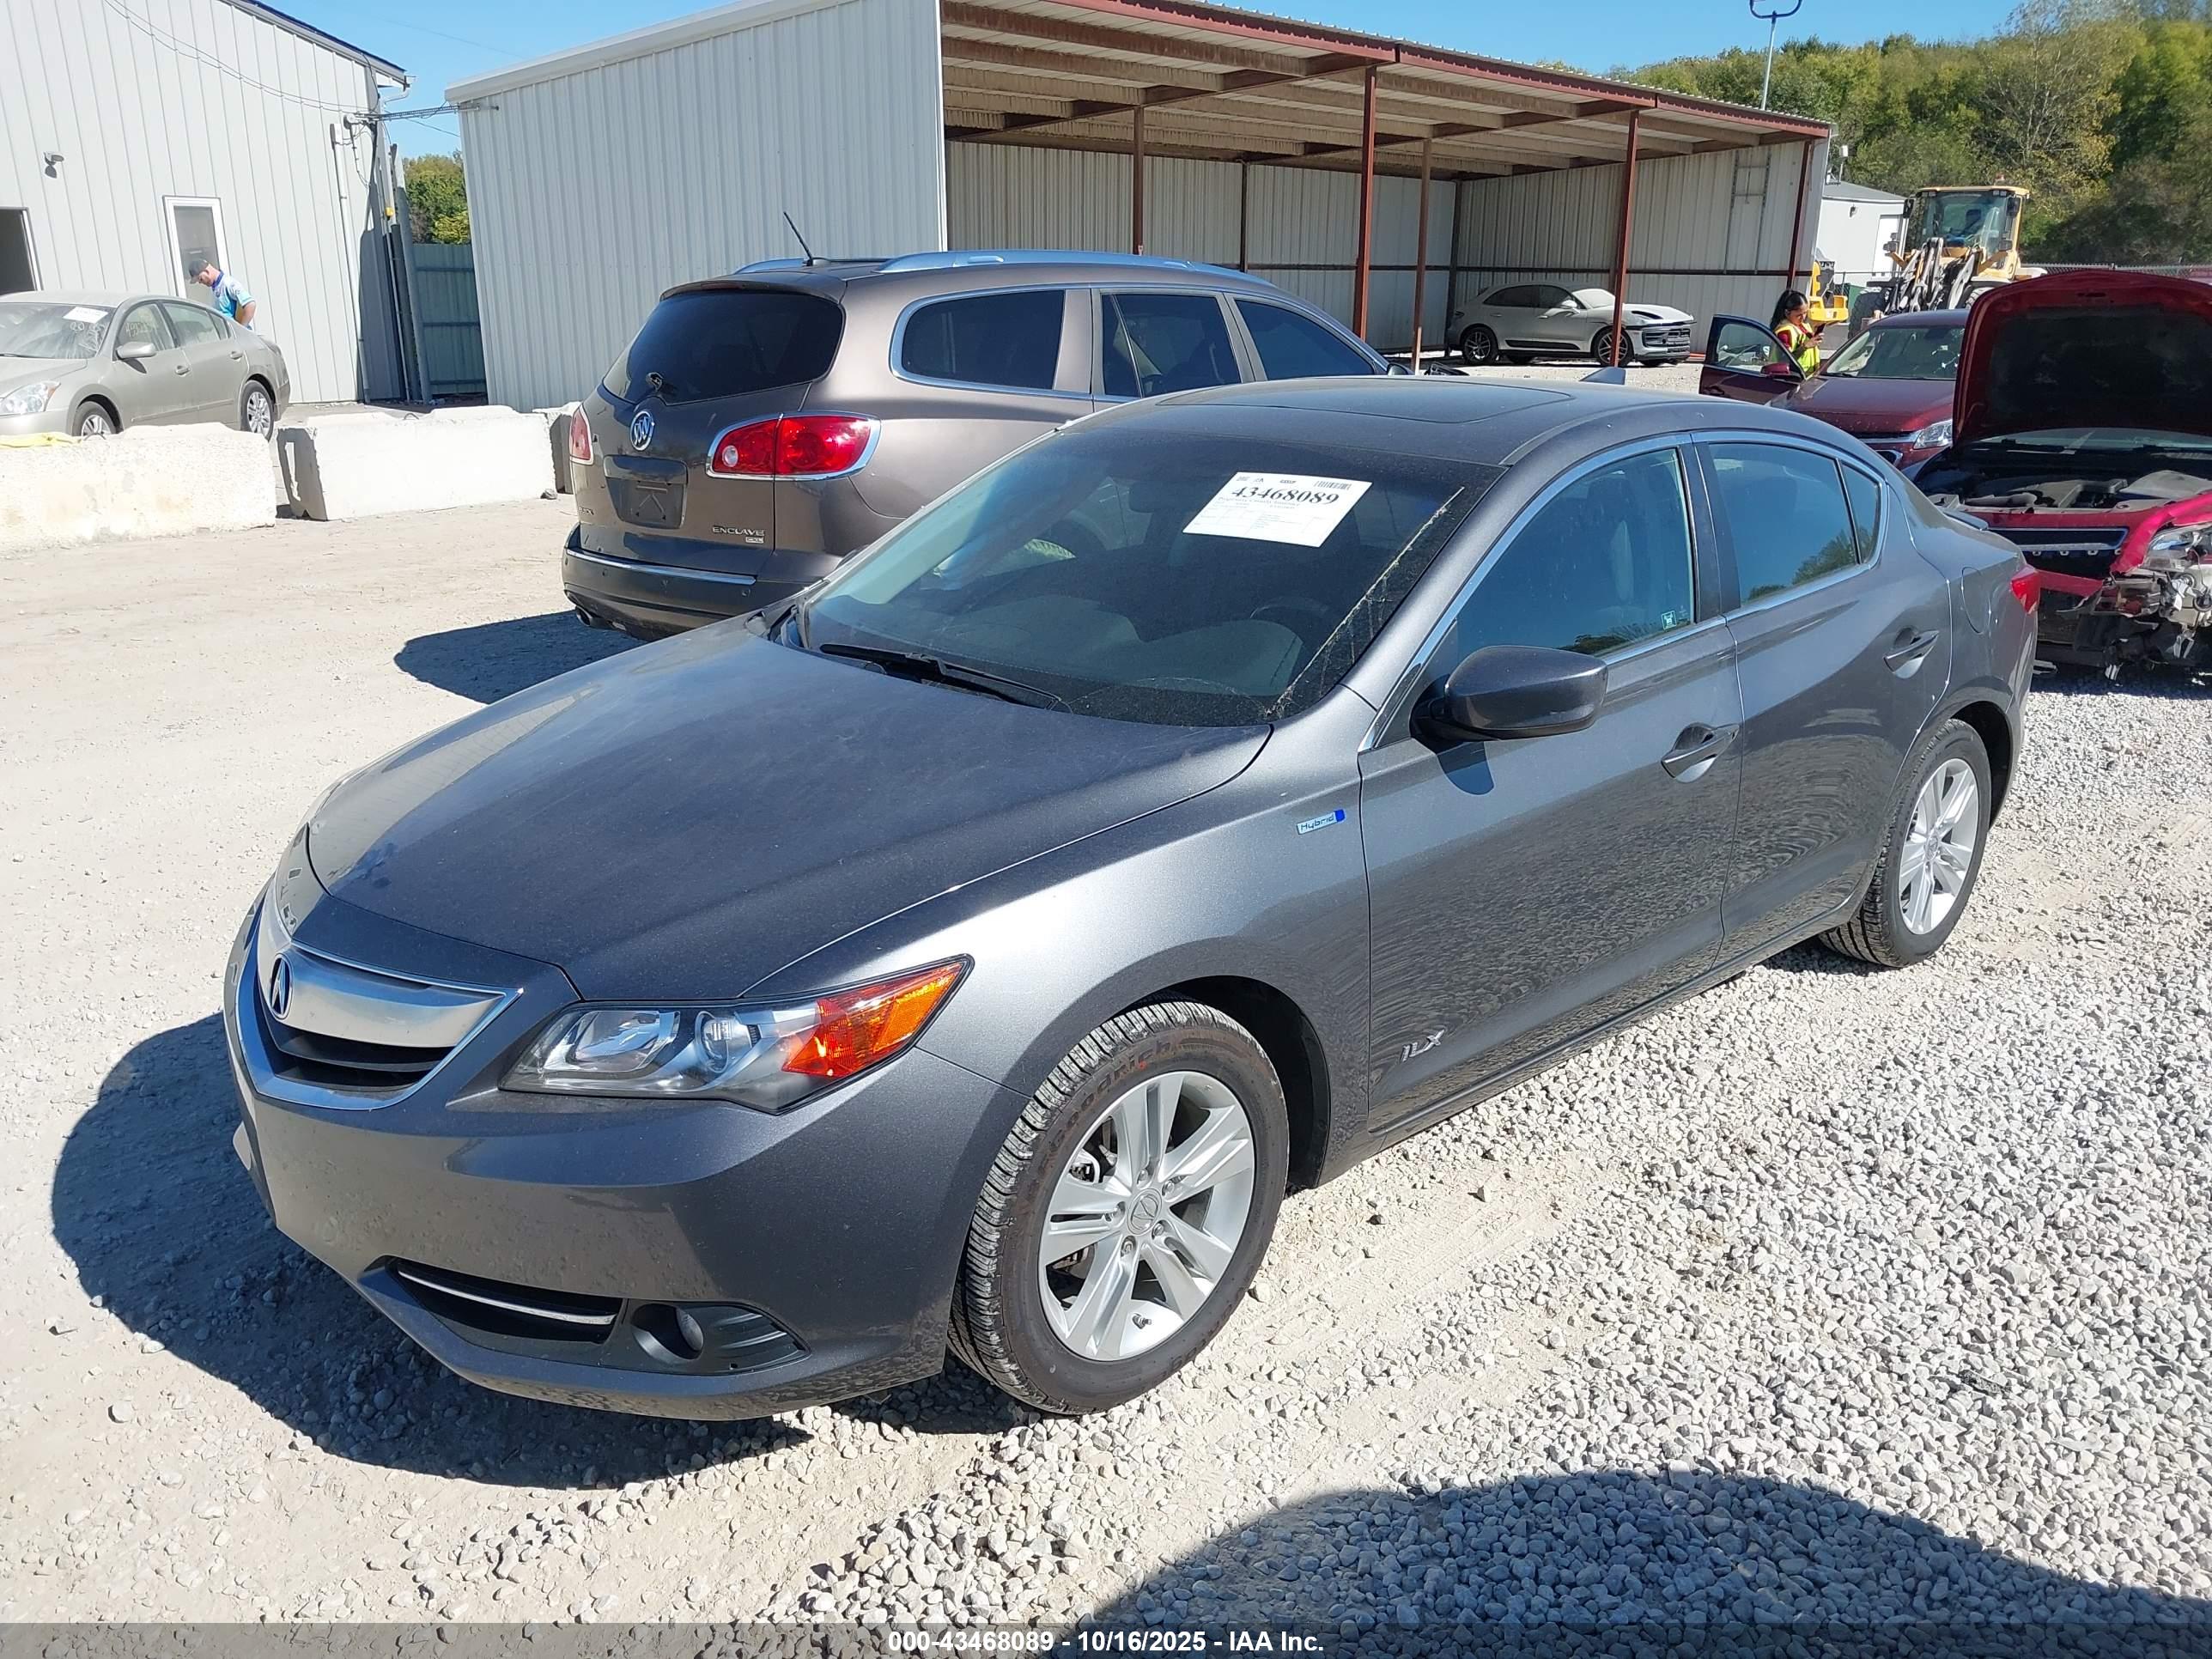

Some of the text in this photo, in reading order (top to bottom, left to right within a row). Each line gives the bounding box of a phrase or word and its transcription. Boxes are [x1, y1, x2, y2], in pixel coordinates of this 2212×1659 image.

[1231, 486, 1340, 505] 43468089
[712, 526, 765, 537] ENCLAVE
[1300, 813, 1334, 831] Hybrid
